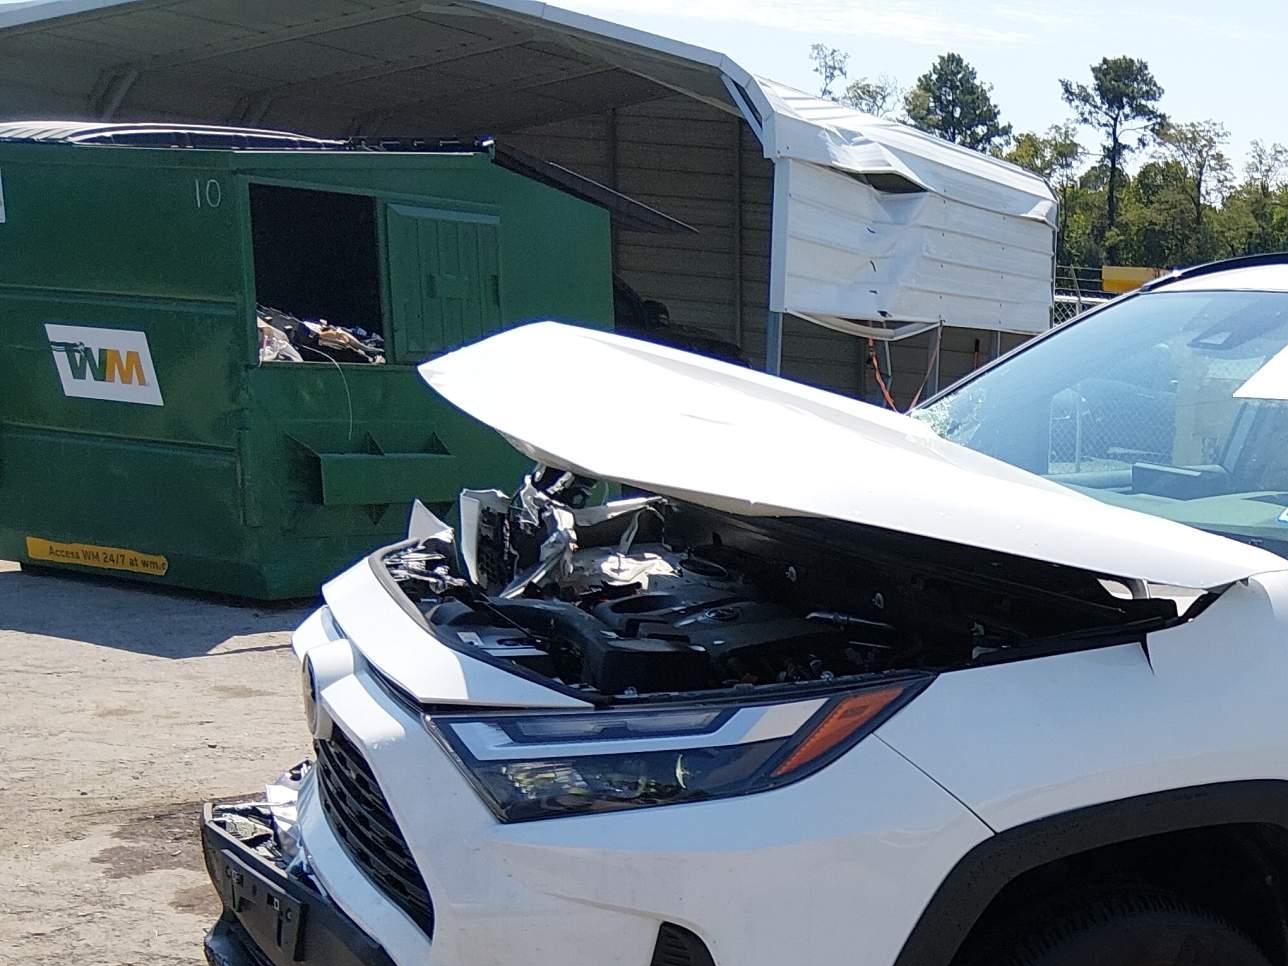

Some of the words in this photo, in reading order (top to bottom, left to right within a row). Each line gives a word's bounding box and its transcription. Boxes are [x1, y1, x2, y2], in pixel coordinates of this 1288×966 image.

[195, 178, 221, 208] 10
[65, 346, 146, 386] WM
[48, 545, 80, 560] Access
[81, 549, 100, 561] WM
[102, 552, 126, 567] 24/7
[128, 556, 139, 567] at
